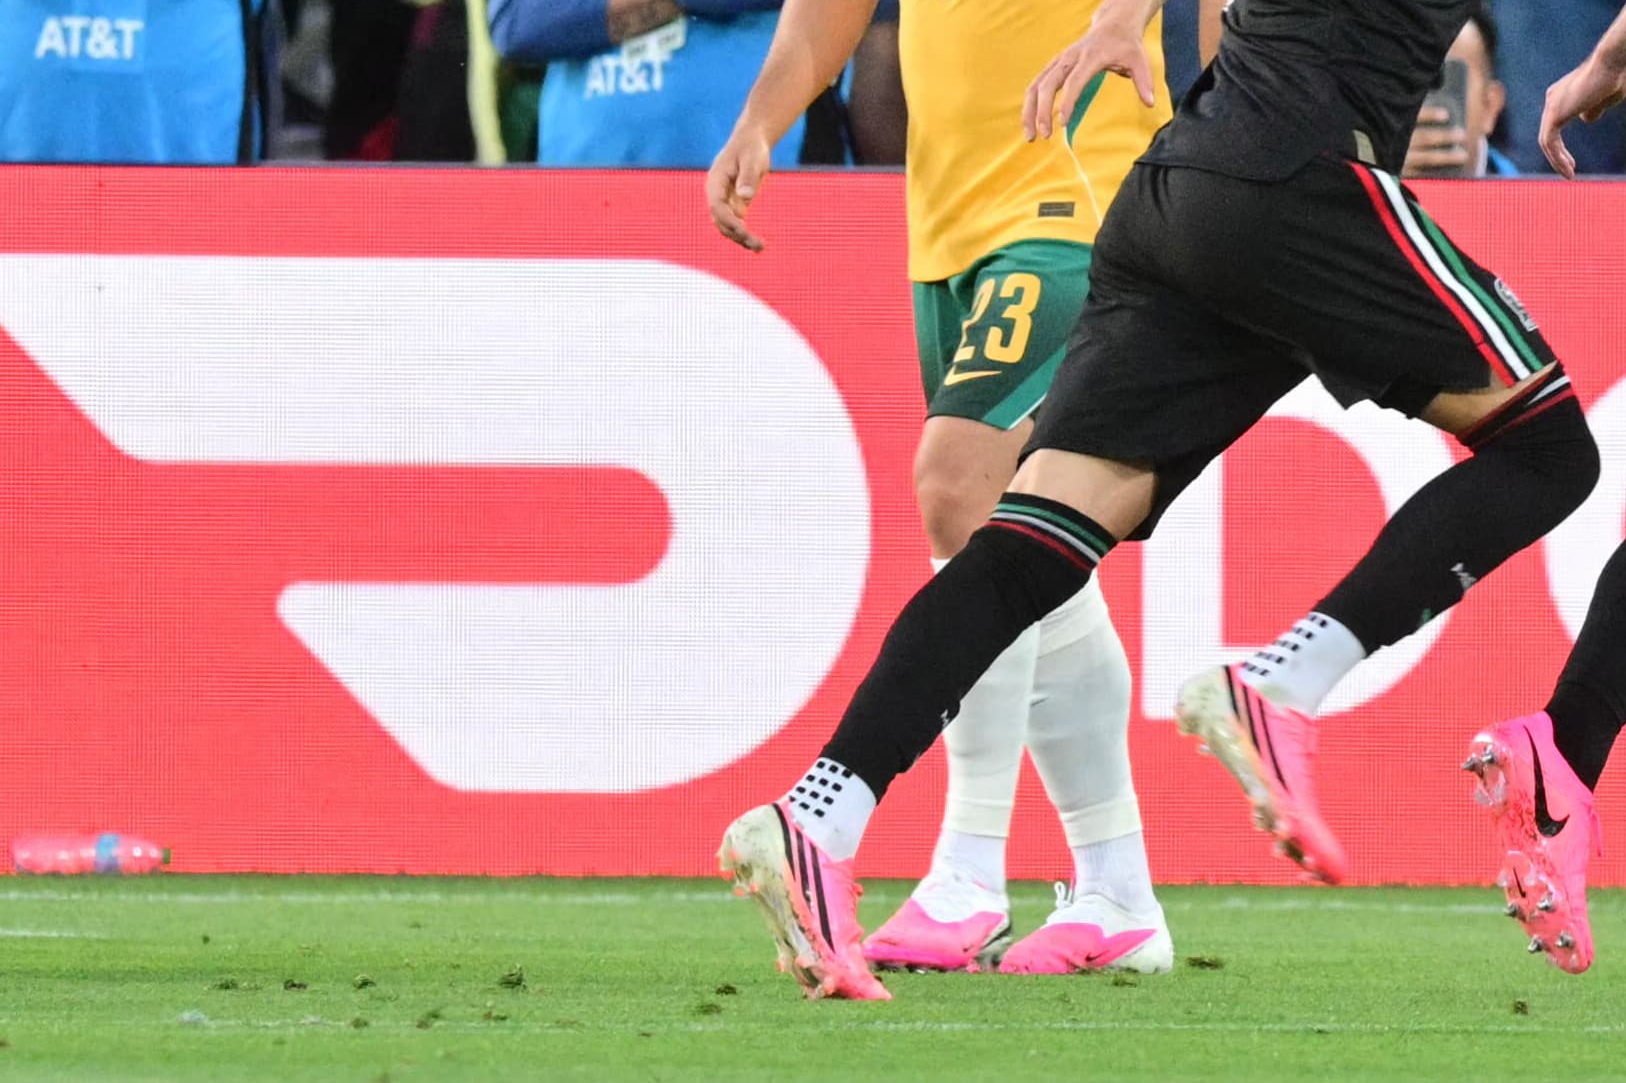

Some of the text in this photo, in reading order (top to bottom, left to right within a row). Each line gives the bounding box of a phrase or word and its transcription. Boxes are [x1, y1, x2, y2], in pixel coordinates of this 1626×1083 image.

[34, 16, 145, 59] AT&T
[584, 51, 671, 99] AT&T
[952, 272, 1041, 364] 23
